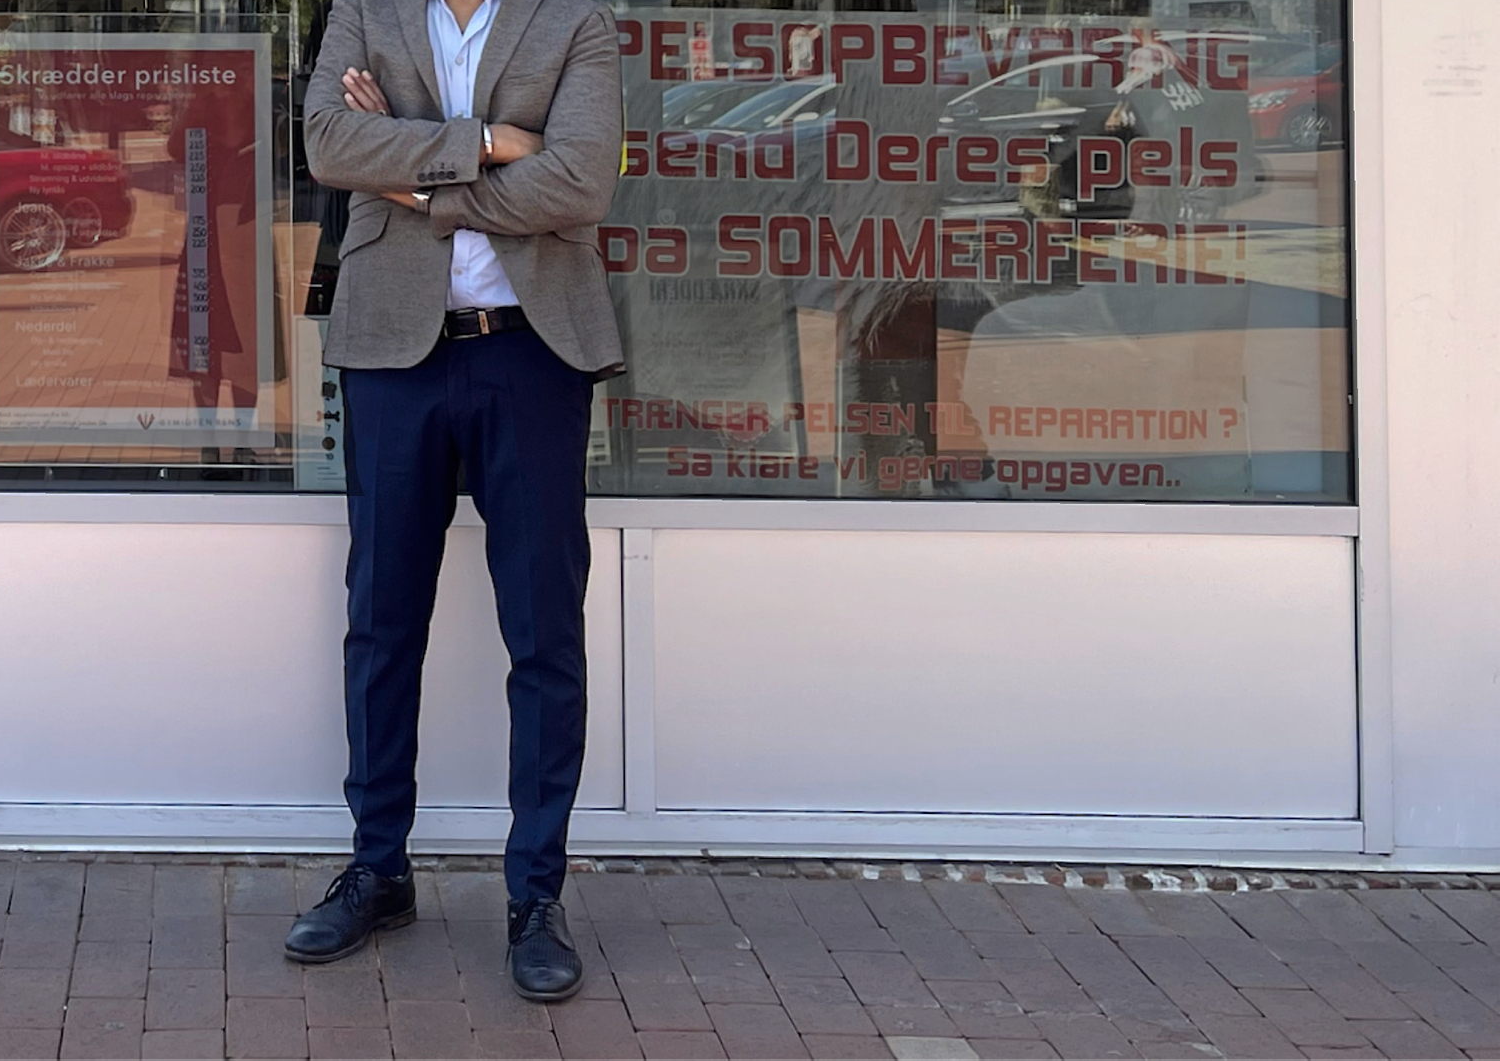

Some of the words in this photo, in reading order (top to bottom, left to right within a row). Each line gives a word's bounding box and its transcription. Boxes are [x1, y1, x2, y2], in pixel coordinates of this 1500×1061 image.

[0, 64, 126, 85] Skrædder
[135, 64, 237, 90] prisliste
[624, 118, 796, 181] send
[825, 118, 1049, 187] Deres
[1078, 125, 1239, 201] pels
[14, 201, 54, 214] Jeans
[69, 255, 116, 268] Frakke
[718, 213, 1247, 286] SOMMERFERIE!
[15, 321, 77, 333] Nederdel
[601, 398, 770, 433] TRÆNGER
[784, 402, 916, 436] PELSEN
[924, 402, 976, 436] TIL
[989, 406, 1207, 440] REPARATION
[1219, 408, 1238, 438] ?
[727, 448, 819, 480] klare
[834, 450, 866, 481] vi
[879, 454, 983, 491] gerne
[997, 458, 1181, 492] opgaven..
